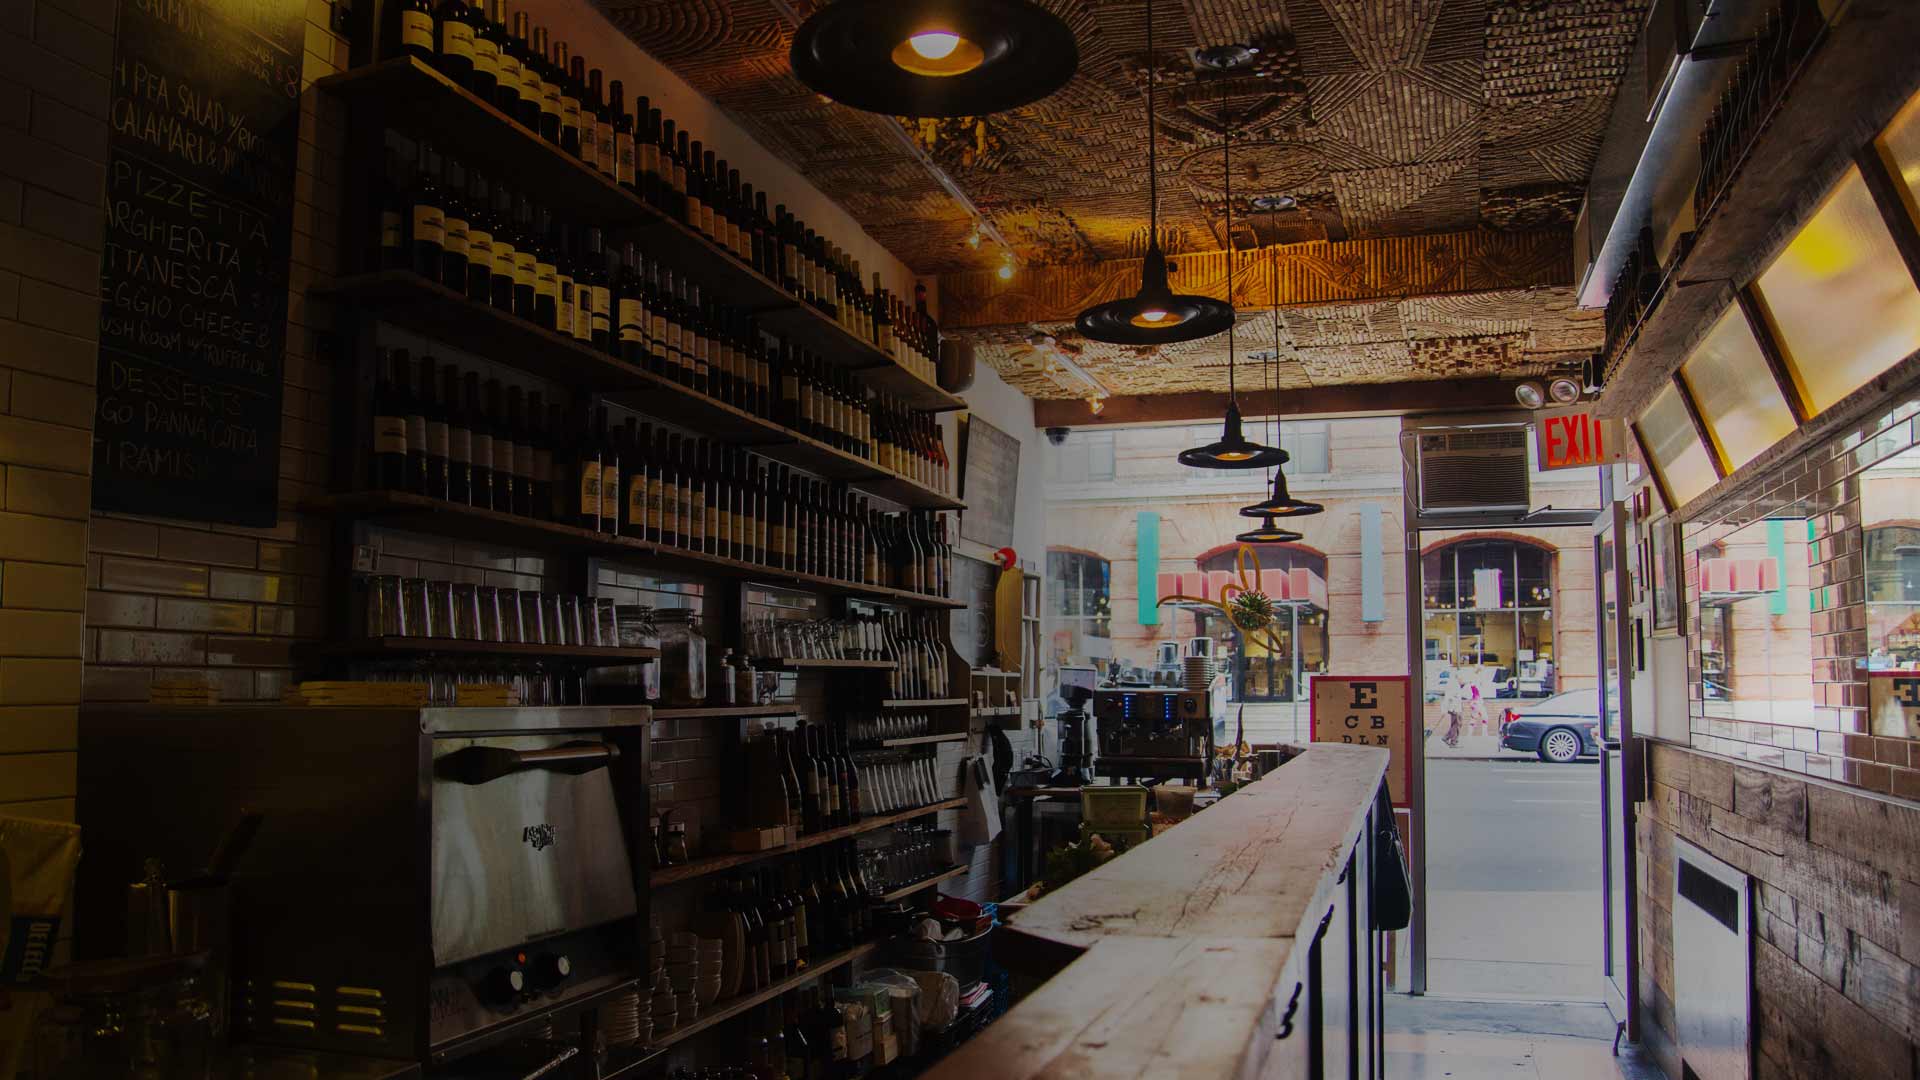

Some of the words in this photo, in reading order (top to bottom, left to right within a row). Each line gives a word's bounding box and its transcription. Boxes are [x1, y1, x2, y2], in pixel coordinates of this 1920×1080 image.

[177, 83, 225, 136] SALAD
[112, 97, 204, 166] CALAMARI
[178, 303, 258, 345] CHEESE
[111, 360, 241, 416] DESSERTS
[1349, 682, 1377, 709] E
[1342, 735, 1353, 744] D
[1358, 735, 1369, 745] L
[1376, 735, 1389, 745] N
[1344, 715, 1359, 729] C
[1370, 715, 1385, 729] B
